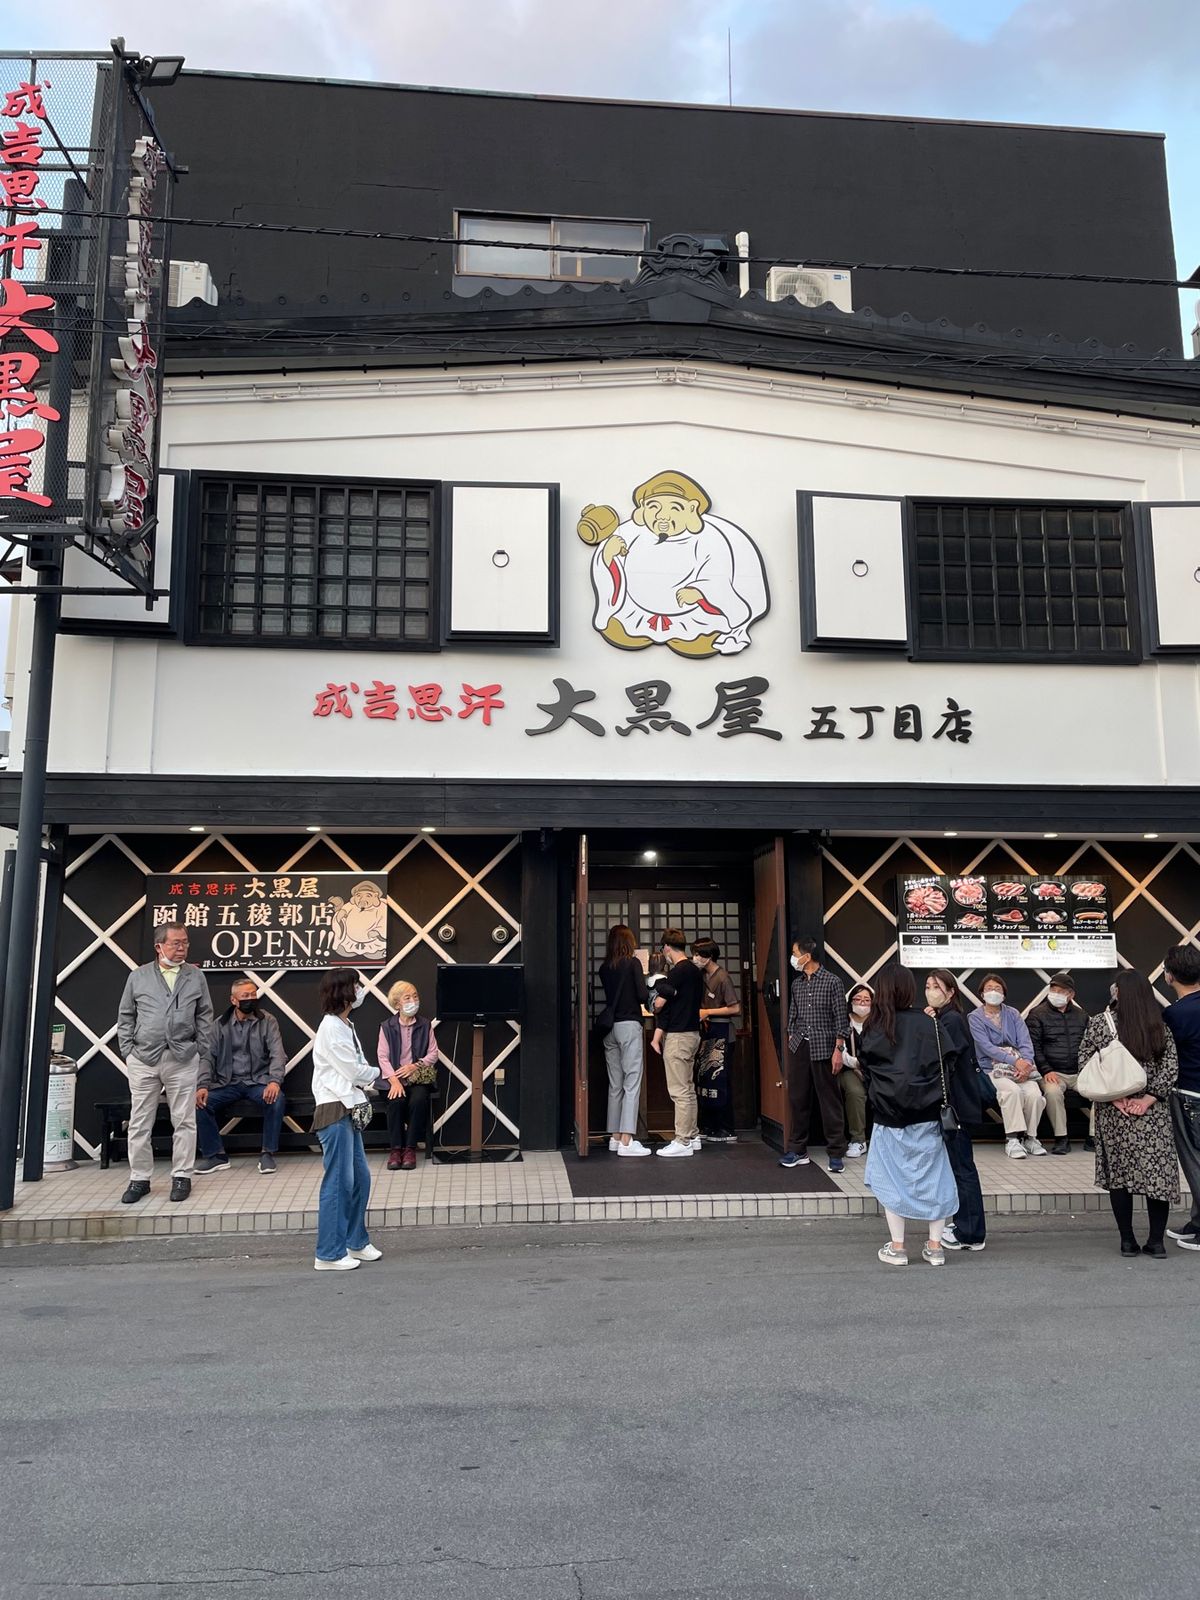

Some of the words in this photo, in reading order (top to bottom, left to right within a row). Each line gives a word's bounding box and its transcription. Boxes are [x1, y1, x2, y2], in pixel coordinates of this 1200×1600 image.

[312, 680, 505, 726] 成吉思汗
[525, 676, 783, 741] 大黒屋
[802, 697, 974, 744] 五丁目店
[168, 882, 238, 896] 成吉思汗
[242, 877, 320, 899] 大黒屋
[152, 902, 334, 928] 函館五稜郭店
[211, 929, 334, 958] OPEN!!
[202, 959, 328, 968] 詳しくはホームページをご覧ください
